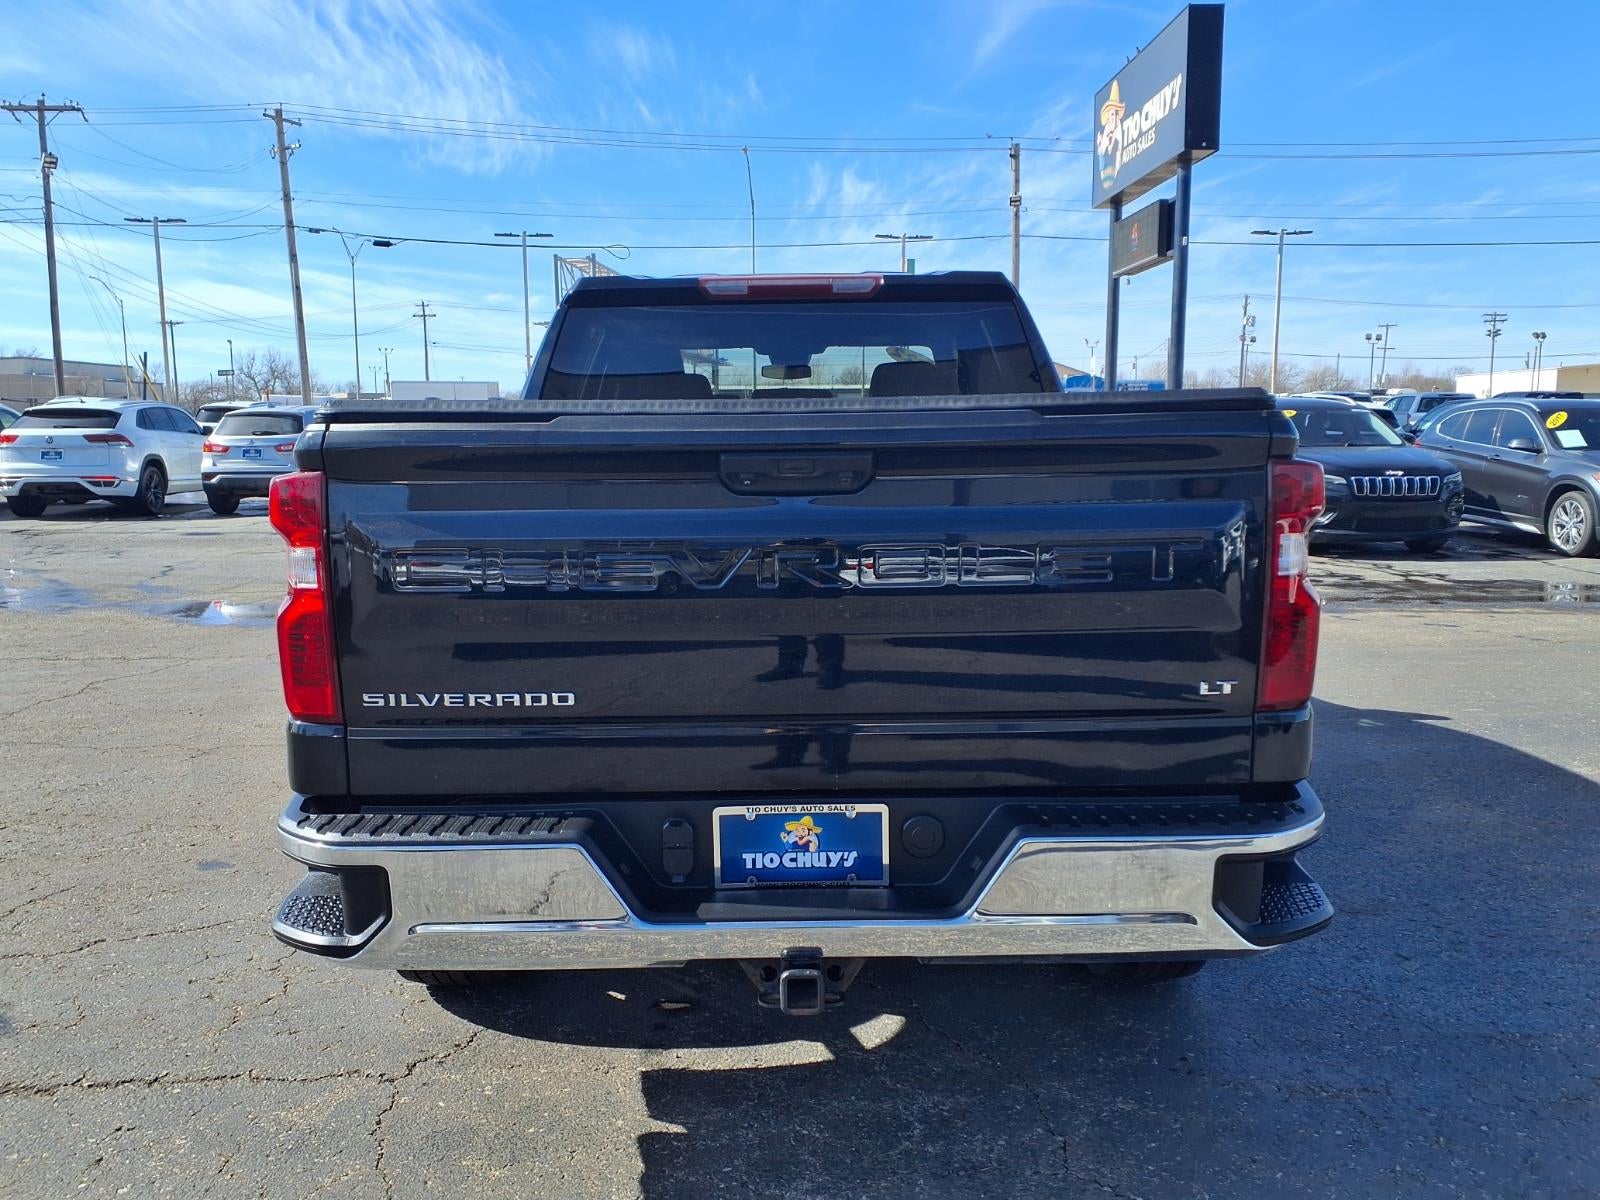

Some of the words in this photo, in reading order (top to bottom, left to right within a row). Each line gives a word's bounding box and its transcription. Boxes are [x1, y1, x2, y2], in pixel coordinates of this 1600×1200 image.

[1122, 111, 1141, 147] TIO
[1140, 72, 1182, 133] CHUY'S
[1122, 141, 1137, 166] AUTO
[1137, 127, 1156, 155] SALES
[391, 538, 1206, 593] CHEVROLET
[362, 692, 576, 707] SILVERADO
[1199, 680, 1239, 695] LT
[763, 805, 797, 813] CHUY'S
[827, 804, 856, 812] SALES
